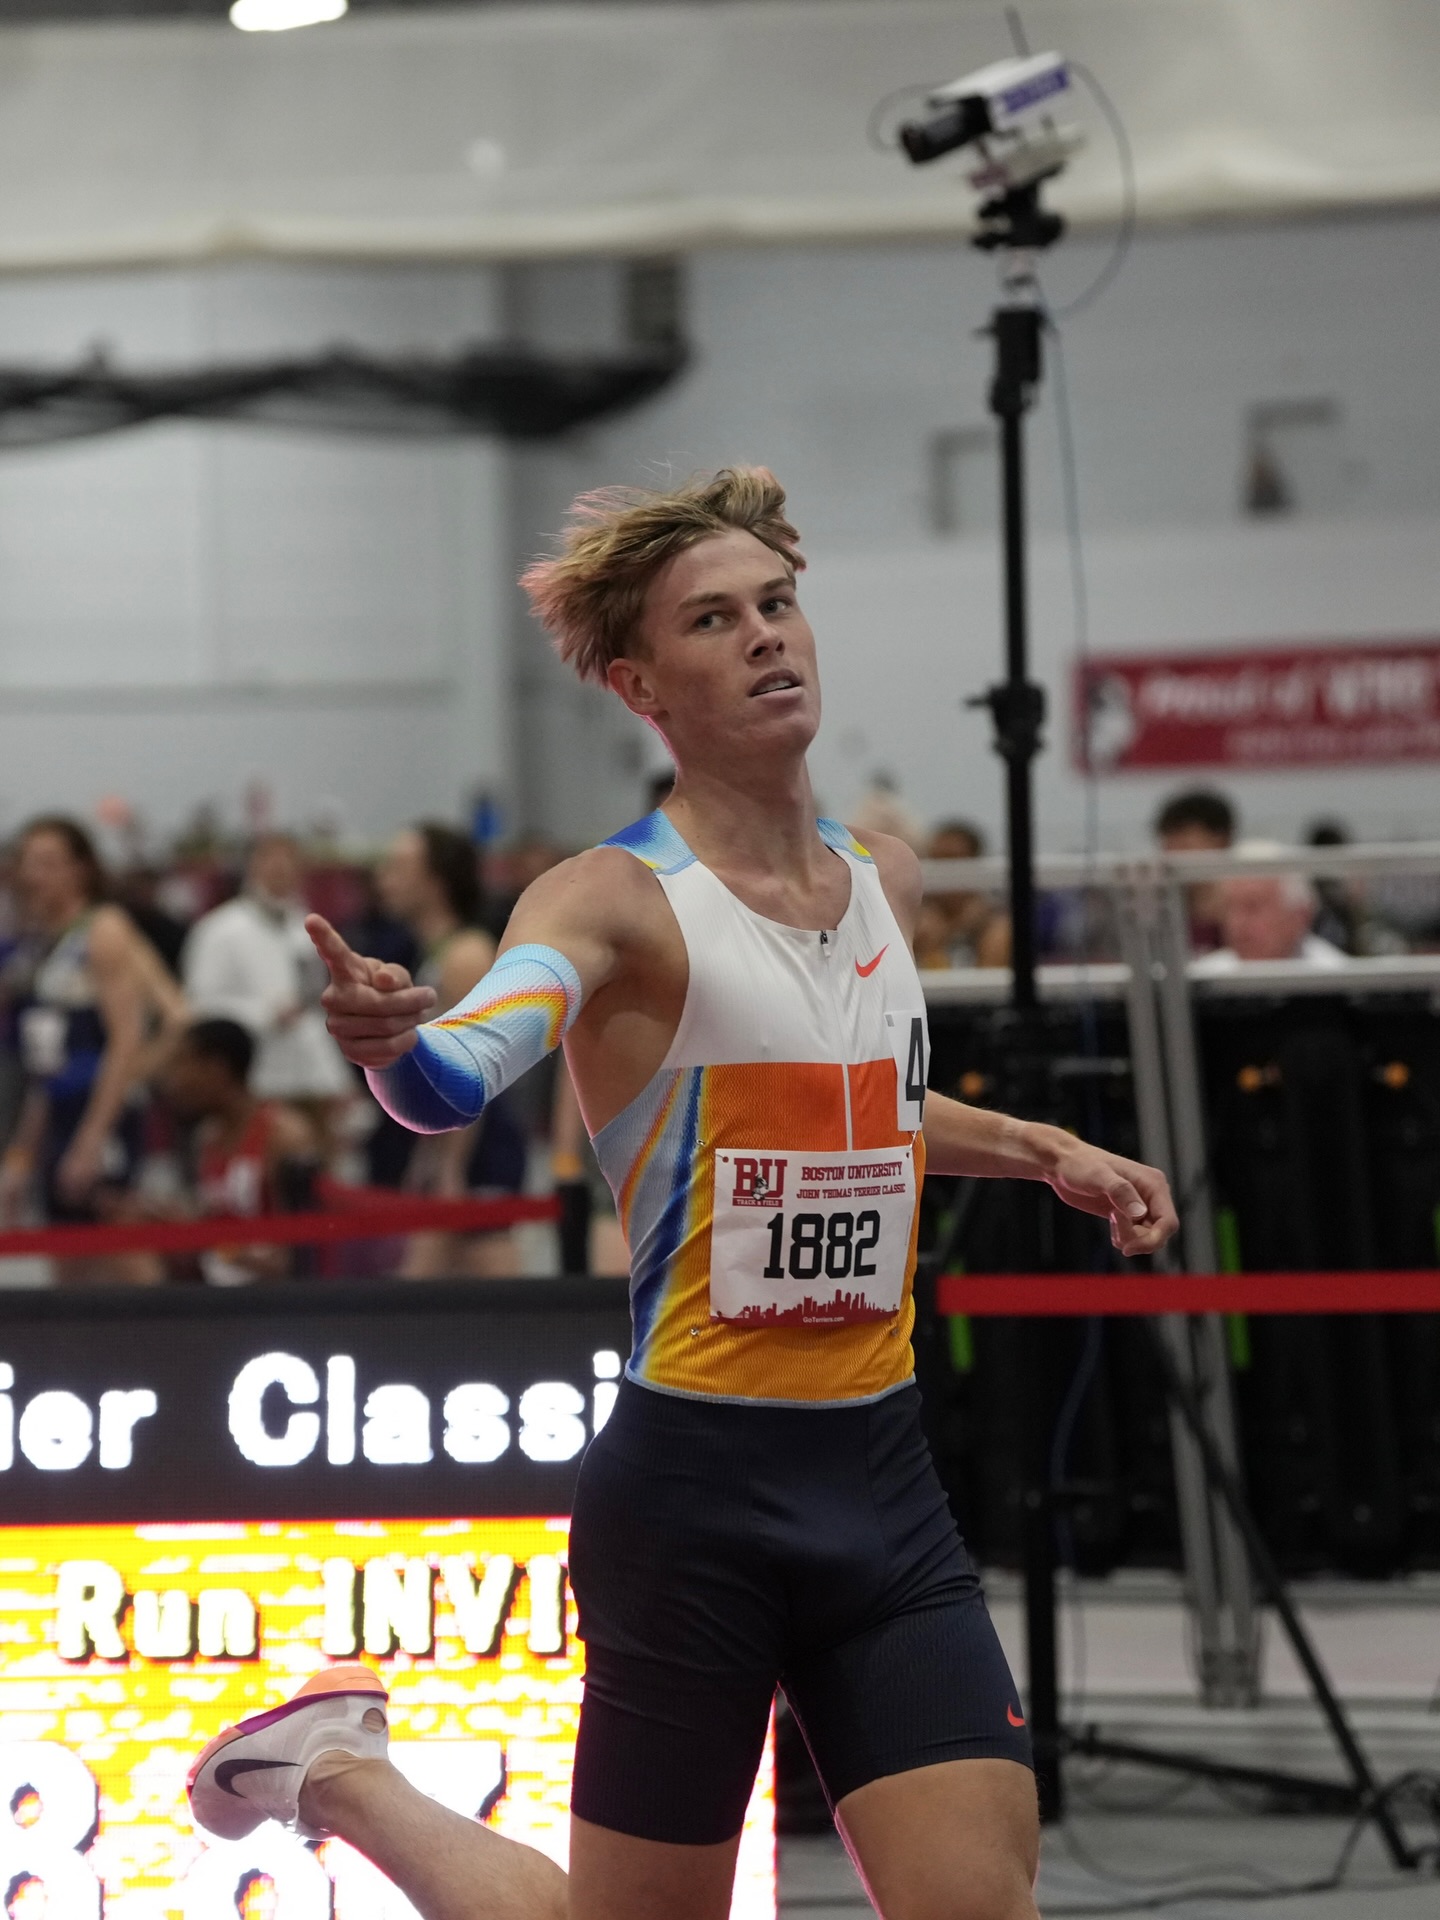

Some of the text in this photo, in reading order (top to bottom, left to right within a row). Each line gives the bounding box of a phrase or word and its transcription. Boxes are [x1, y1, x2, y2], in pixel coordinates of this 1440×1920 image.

[905, 1017, 926, 1123] 4
[732, 1157, 788, 1198] BU
[796, 1183, 906, 1199] JOHN THOMAS TERRIER CLASSIC
[801, 1161, 903, 1181] BOSTON UNIVERSITY
[763, 1209, 881, 1280] 1882
[56, 1553, 563, 1658] Run INVI
